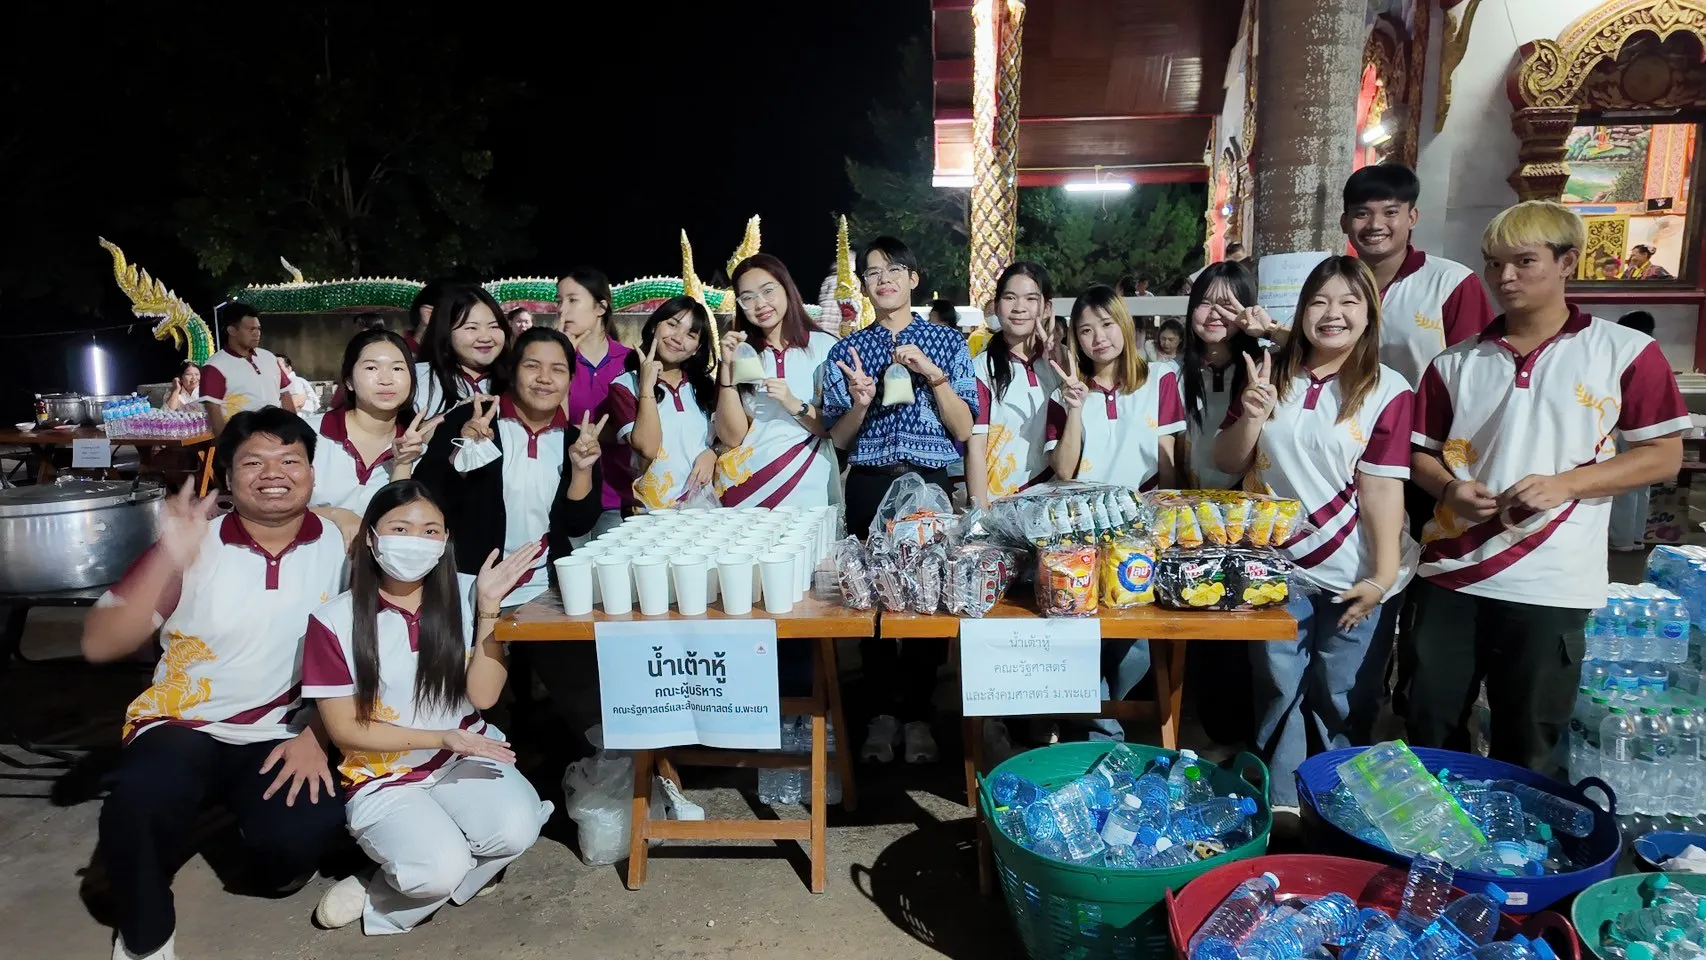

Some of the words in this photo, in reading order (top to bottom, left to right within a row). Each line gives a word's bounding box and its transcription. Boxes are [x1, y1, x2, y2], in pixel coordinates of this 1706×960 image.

[1009, 631, 1050, 652] น้ำเต้าหู้
[647, 645, 726, 684] น้ำเต้าหู้
[993, 659, 1067, 677] คณะรัฐศาสตร์
[655, 682, 723, 698] คณะผู้บริหาร
[965, 685, 1049, 701] และสังคมศาสตร์
[1053, 688, 1098, 699] ม.พะเยา
[612, 700, 733, 716] คณะรัฐศาสตร์และสังคมศาสตร์
[734, 703, 768, 714] ม.พะเยา
